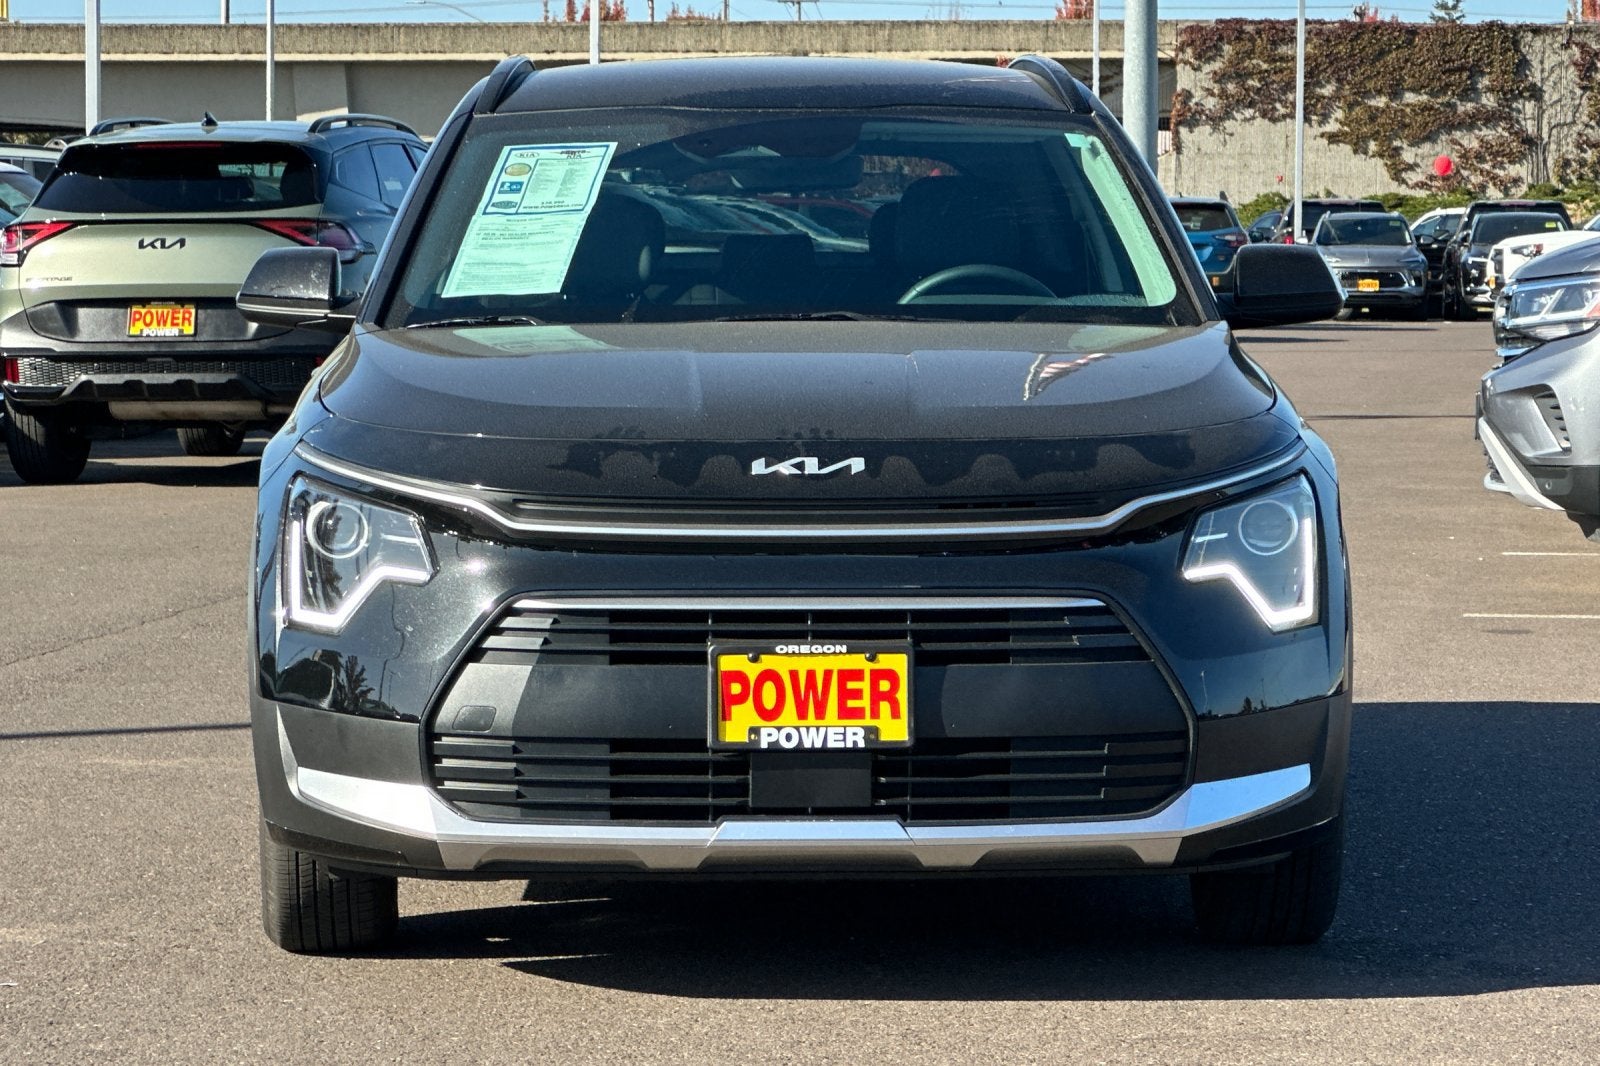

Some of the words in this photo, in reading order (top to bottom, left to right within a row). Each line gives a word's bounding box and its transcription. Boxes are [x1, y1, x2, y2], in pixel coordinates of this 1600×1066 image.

[138, 237, 186, 249] KIA
[131, 308, 193, 327] POWER
[142, 328, 179, 336] POWER
[751, 456, 866, 475] KIA
[775, 644, 848, 654] OREGON
[720, 668, 902, 722] POWER
[759, 726, 867, 749] POWER
